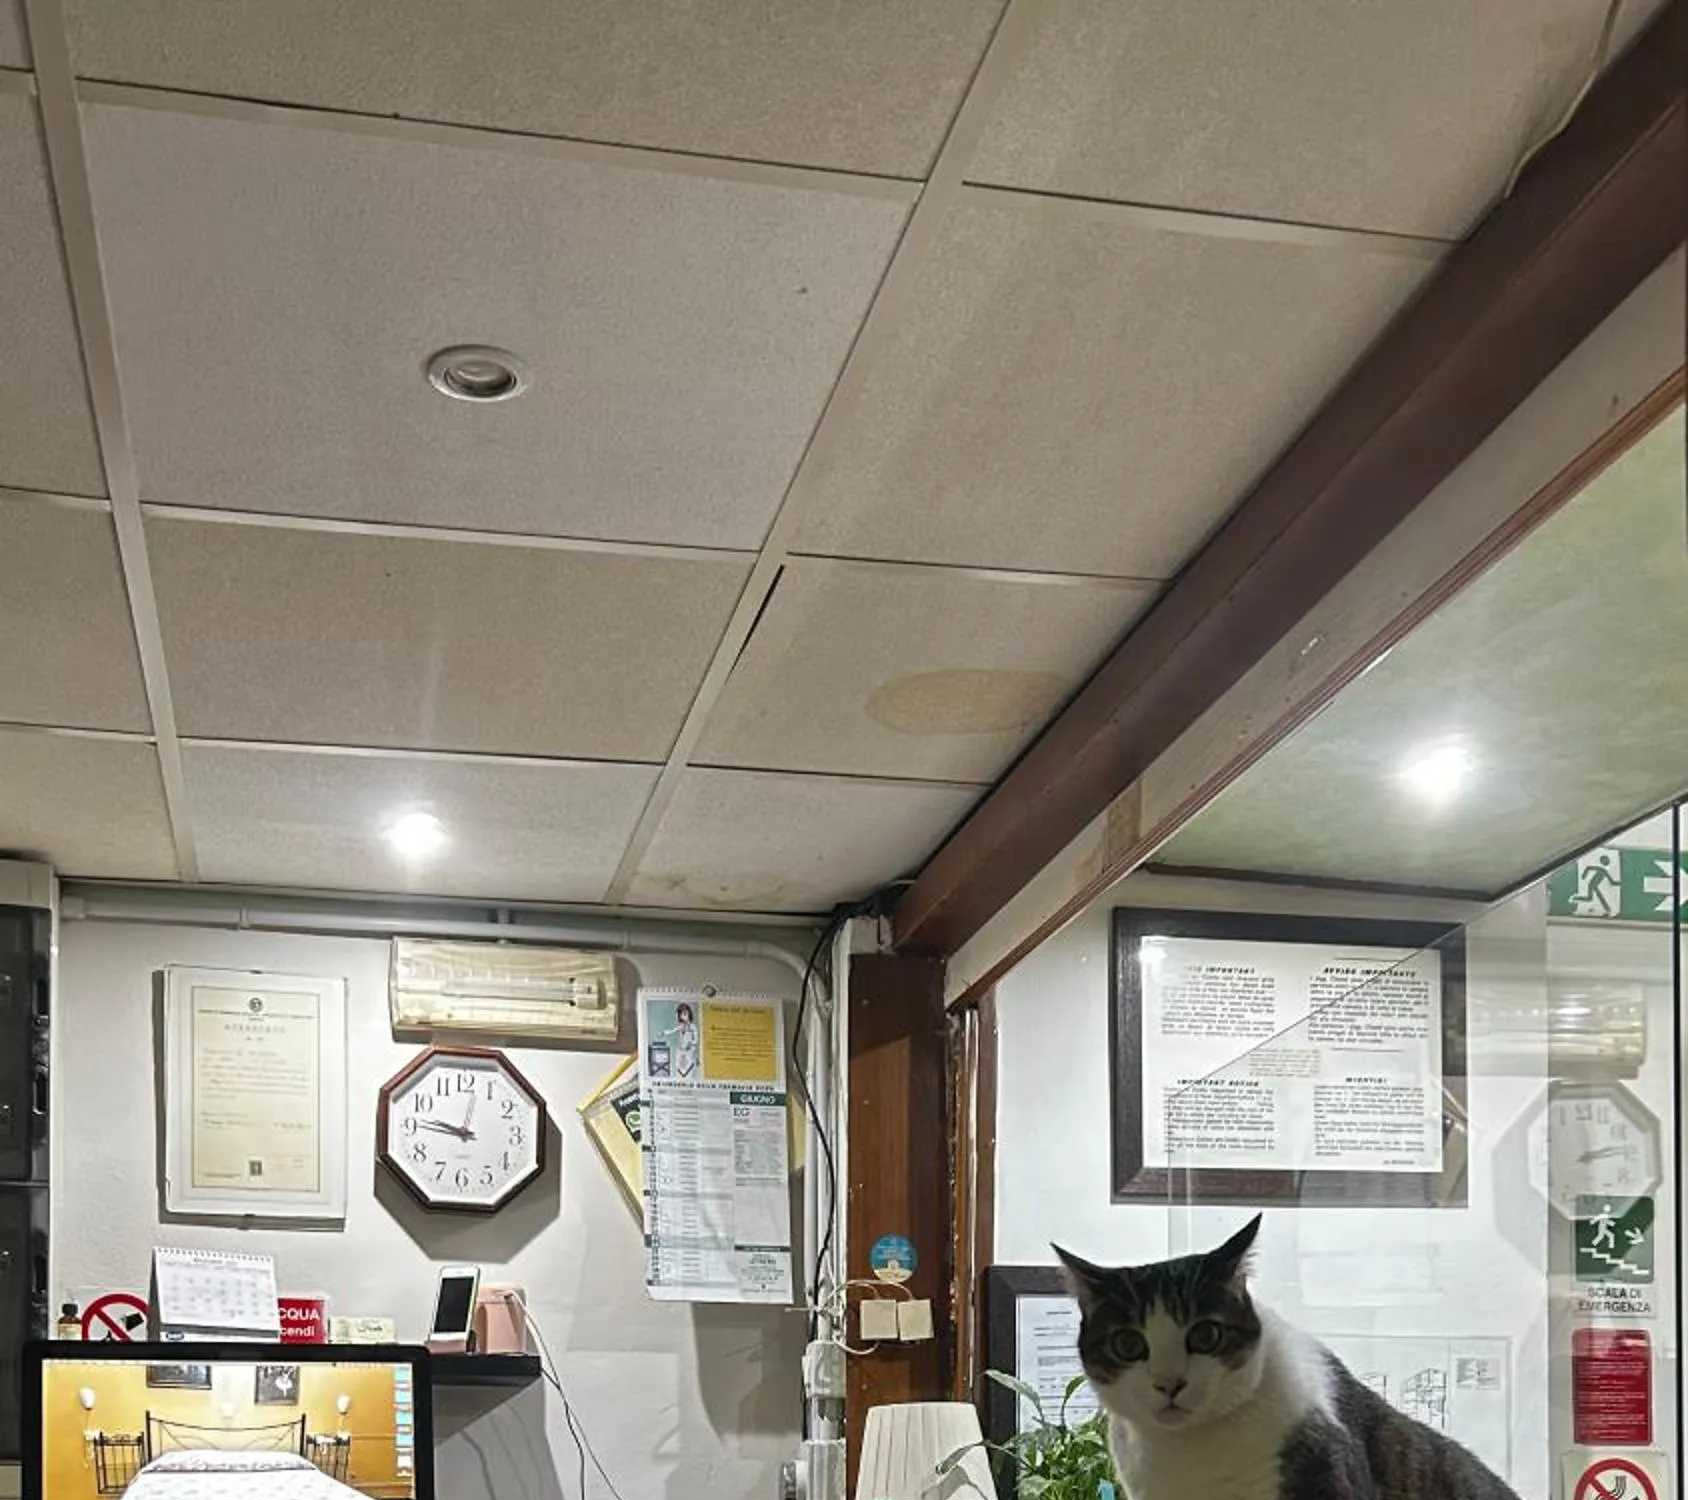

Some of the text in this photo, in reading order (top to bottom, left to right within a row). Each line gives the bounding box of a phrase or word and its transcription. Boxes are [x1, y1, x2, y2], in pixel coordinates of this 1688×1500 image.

[437, 1077, 449, 1097] 11
[457, 1073, 475, 1093] 12
[487, 1080, 494, 1101] 1
[414, 1092, 433, 1113] 10
[501, 1099, 513, 1119] 2
[404, 1117, 417, 1136] 9
[509, 1125, 522, 1146] 3
[413, 1142, 427, 1163] 8
[500, 1151, 511, 1171] 4
[435, 1161, 446, 1181] 7
[455, 1168, 469, 1188] 6
[479, 1165, 493, 1185] 5
[1588, 1287, 1642, 1299] SCALA DI
[278, 1307, 321, 1321] CQUA
[1578, 1301, 1652, 1313] EMERGENZA
[280, 1326, 315, 1338] cendi
